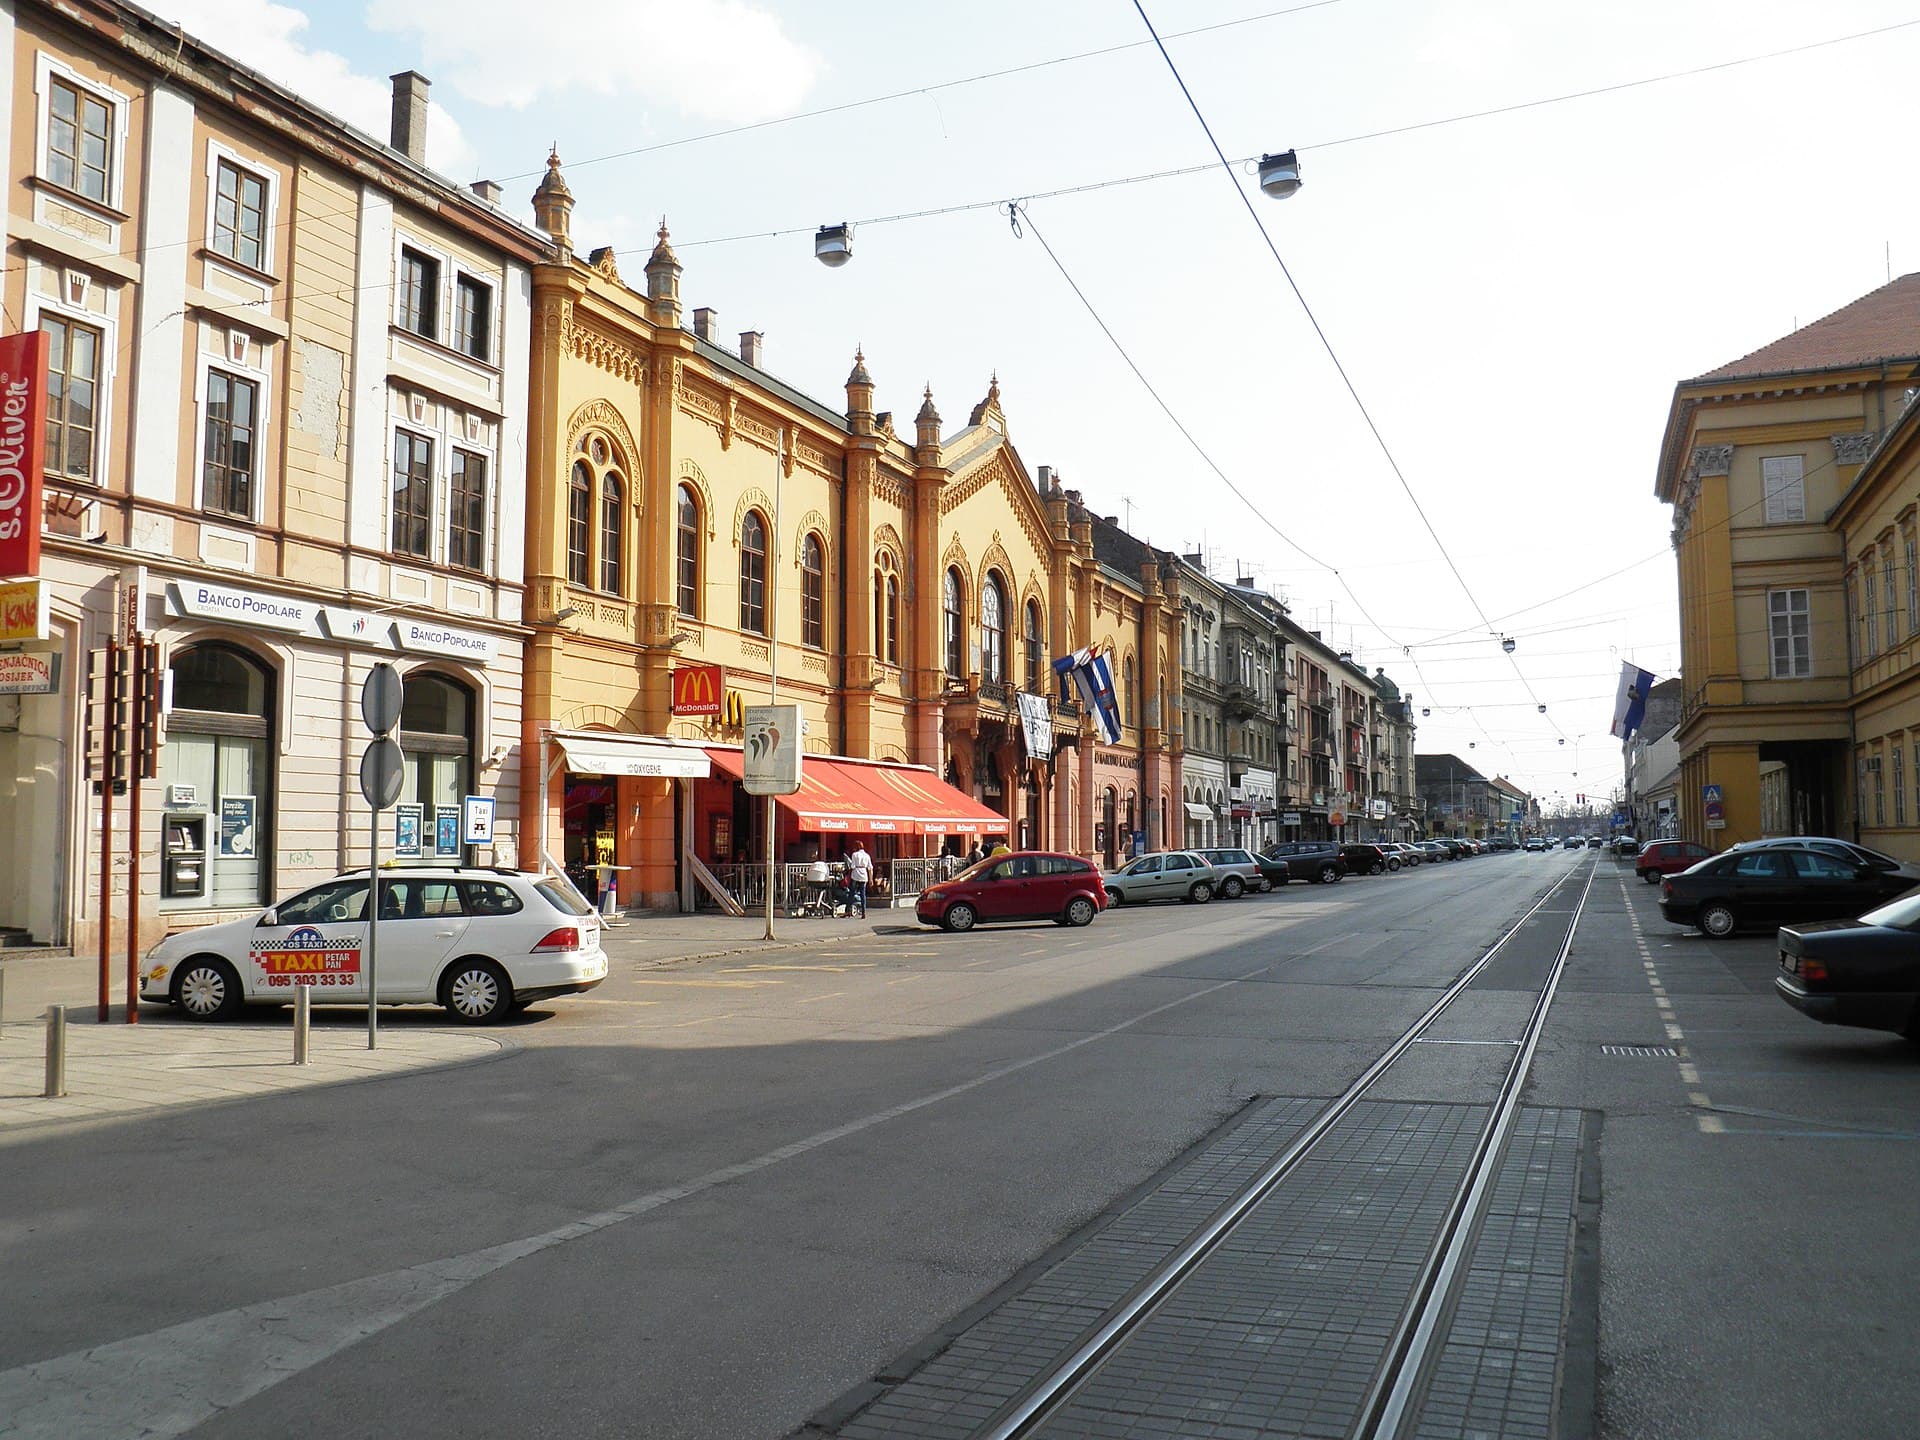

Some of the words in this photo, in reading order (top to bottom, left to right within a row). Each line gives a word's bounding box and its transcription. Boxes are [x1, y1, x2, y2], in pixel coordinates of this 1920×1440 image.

[198, 589, 240, 608] BANCO
[242, 597, 302, 619] POPOLARE
[411, 626, 441, 643] BANCO
[443, 632, 487, 650] POPOLARE
[675, 703, 719, 712] McDonald's
[634, 764, 661, 774] OXYGENE
[474, 805, 488, 815] Taxi
[288, 941, 300, 949] OS
[303, 941, 323, 949] TAXI
[270, 953, 323, 971] TAXI
[325, 953, 350, 961] PETAR
[325, 961, 341, 969] PAN
[268, 975, 291, 987] 095
[294, 974, 317, 987] 303
[320, 974, 336, 986] 33
[339, 974, 354, 986] 33
